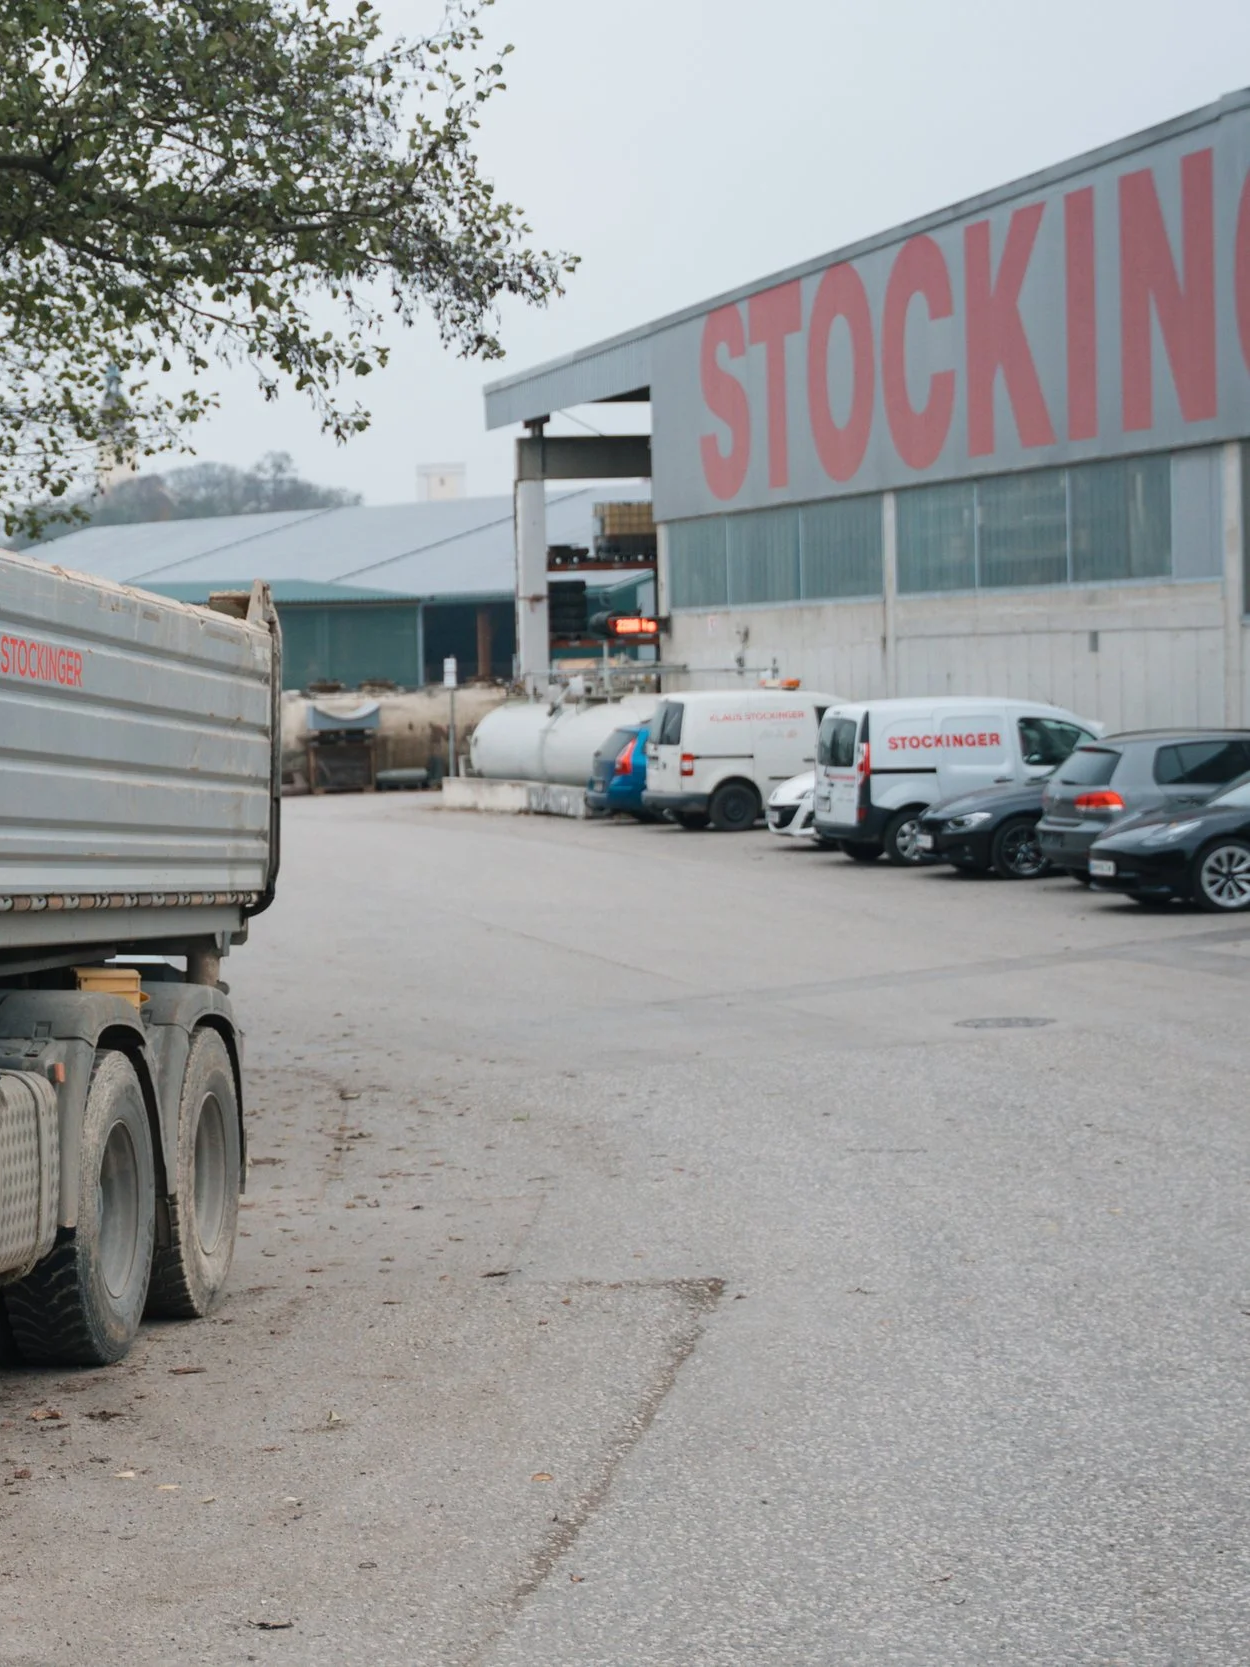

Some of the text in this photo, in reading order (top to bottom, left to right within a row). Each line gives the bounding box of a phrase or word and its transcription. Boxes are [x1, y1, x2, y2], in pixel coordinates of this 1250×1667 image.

[699, 147, 1250, 500] STOCKIN
[0, 635, 83, 687] STOCKINGER
[888, 732, 1001, 750] STOCKINGER
